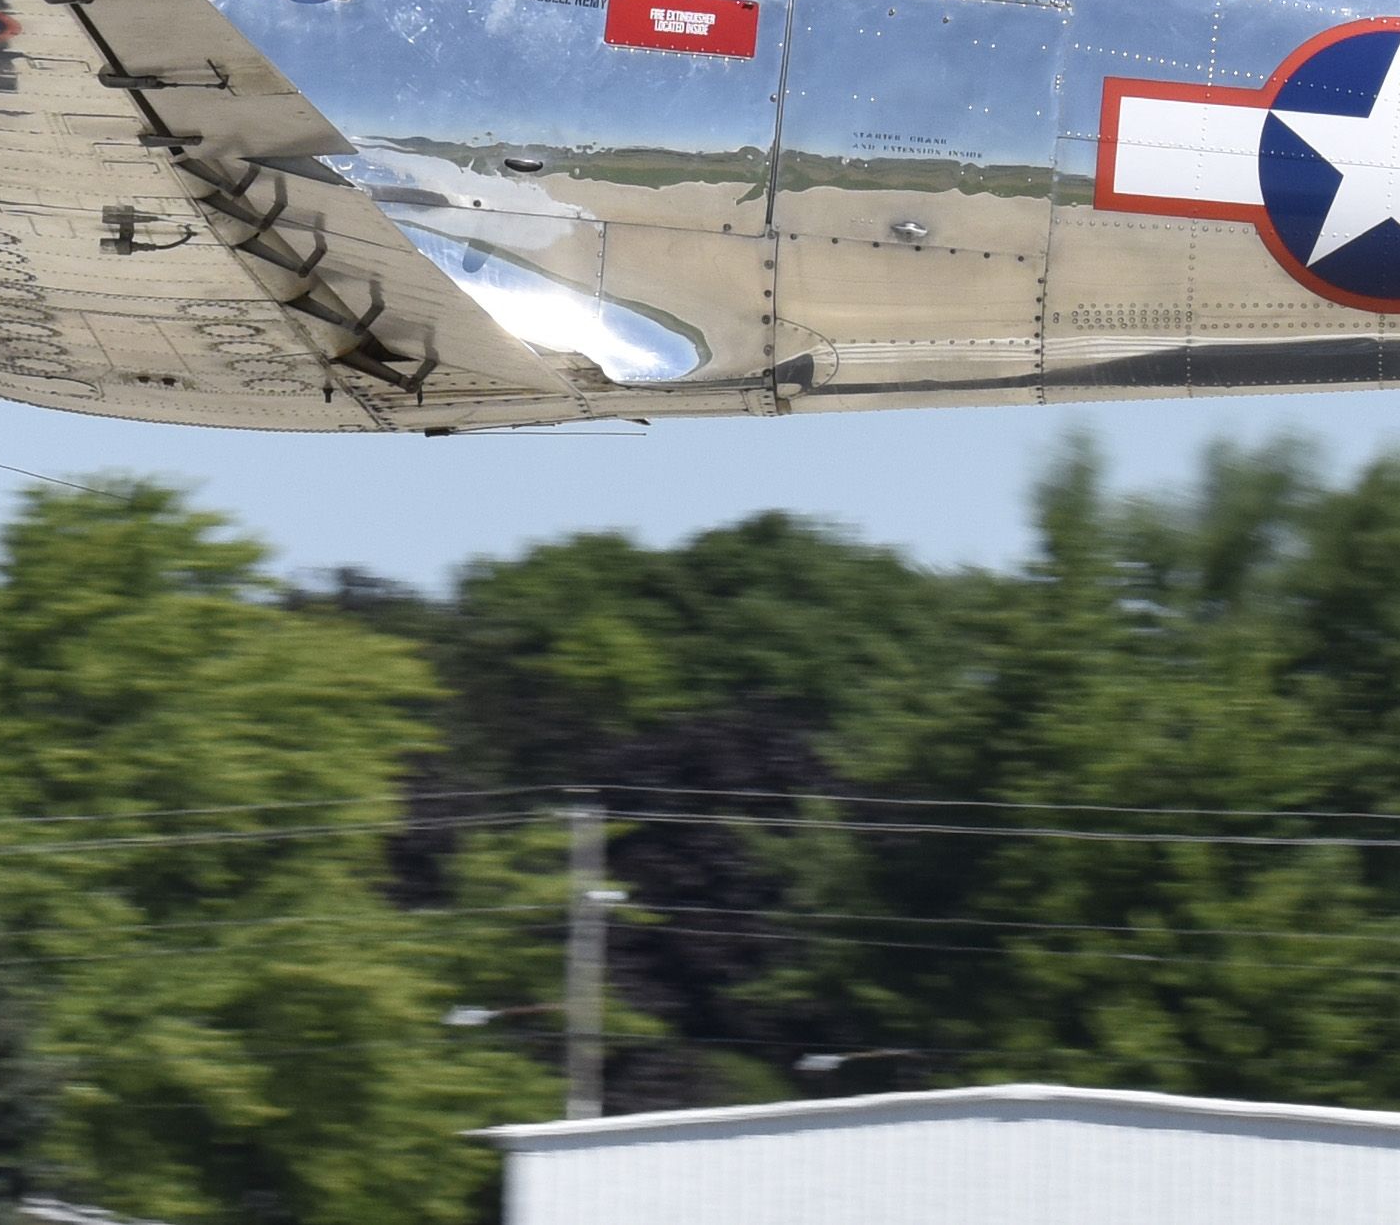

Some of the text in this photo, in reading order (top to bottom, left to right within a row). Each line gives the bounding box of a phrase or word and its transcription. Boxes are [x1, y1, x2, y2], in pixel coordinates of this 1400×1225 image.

[650, 8, 716, 25] FIRE EXTINGUISHER
[654, 19, 709, 36] LOCATED INSIDE
[852, 143, 983, 159] AND EXTENSION INSIDE
